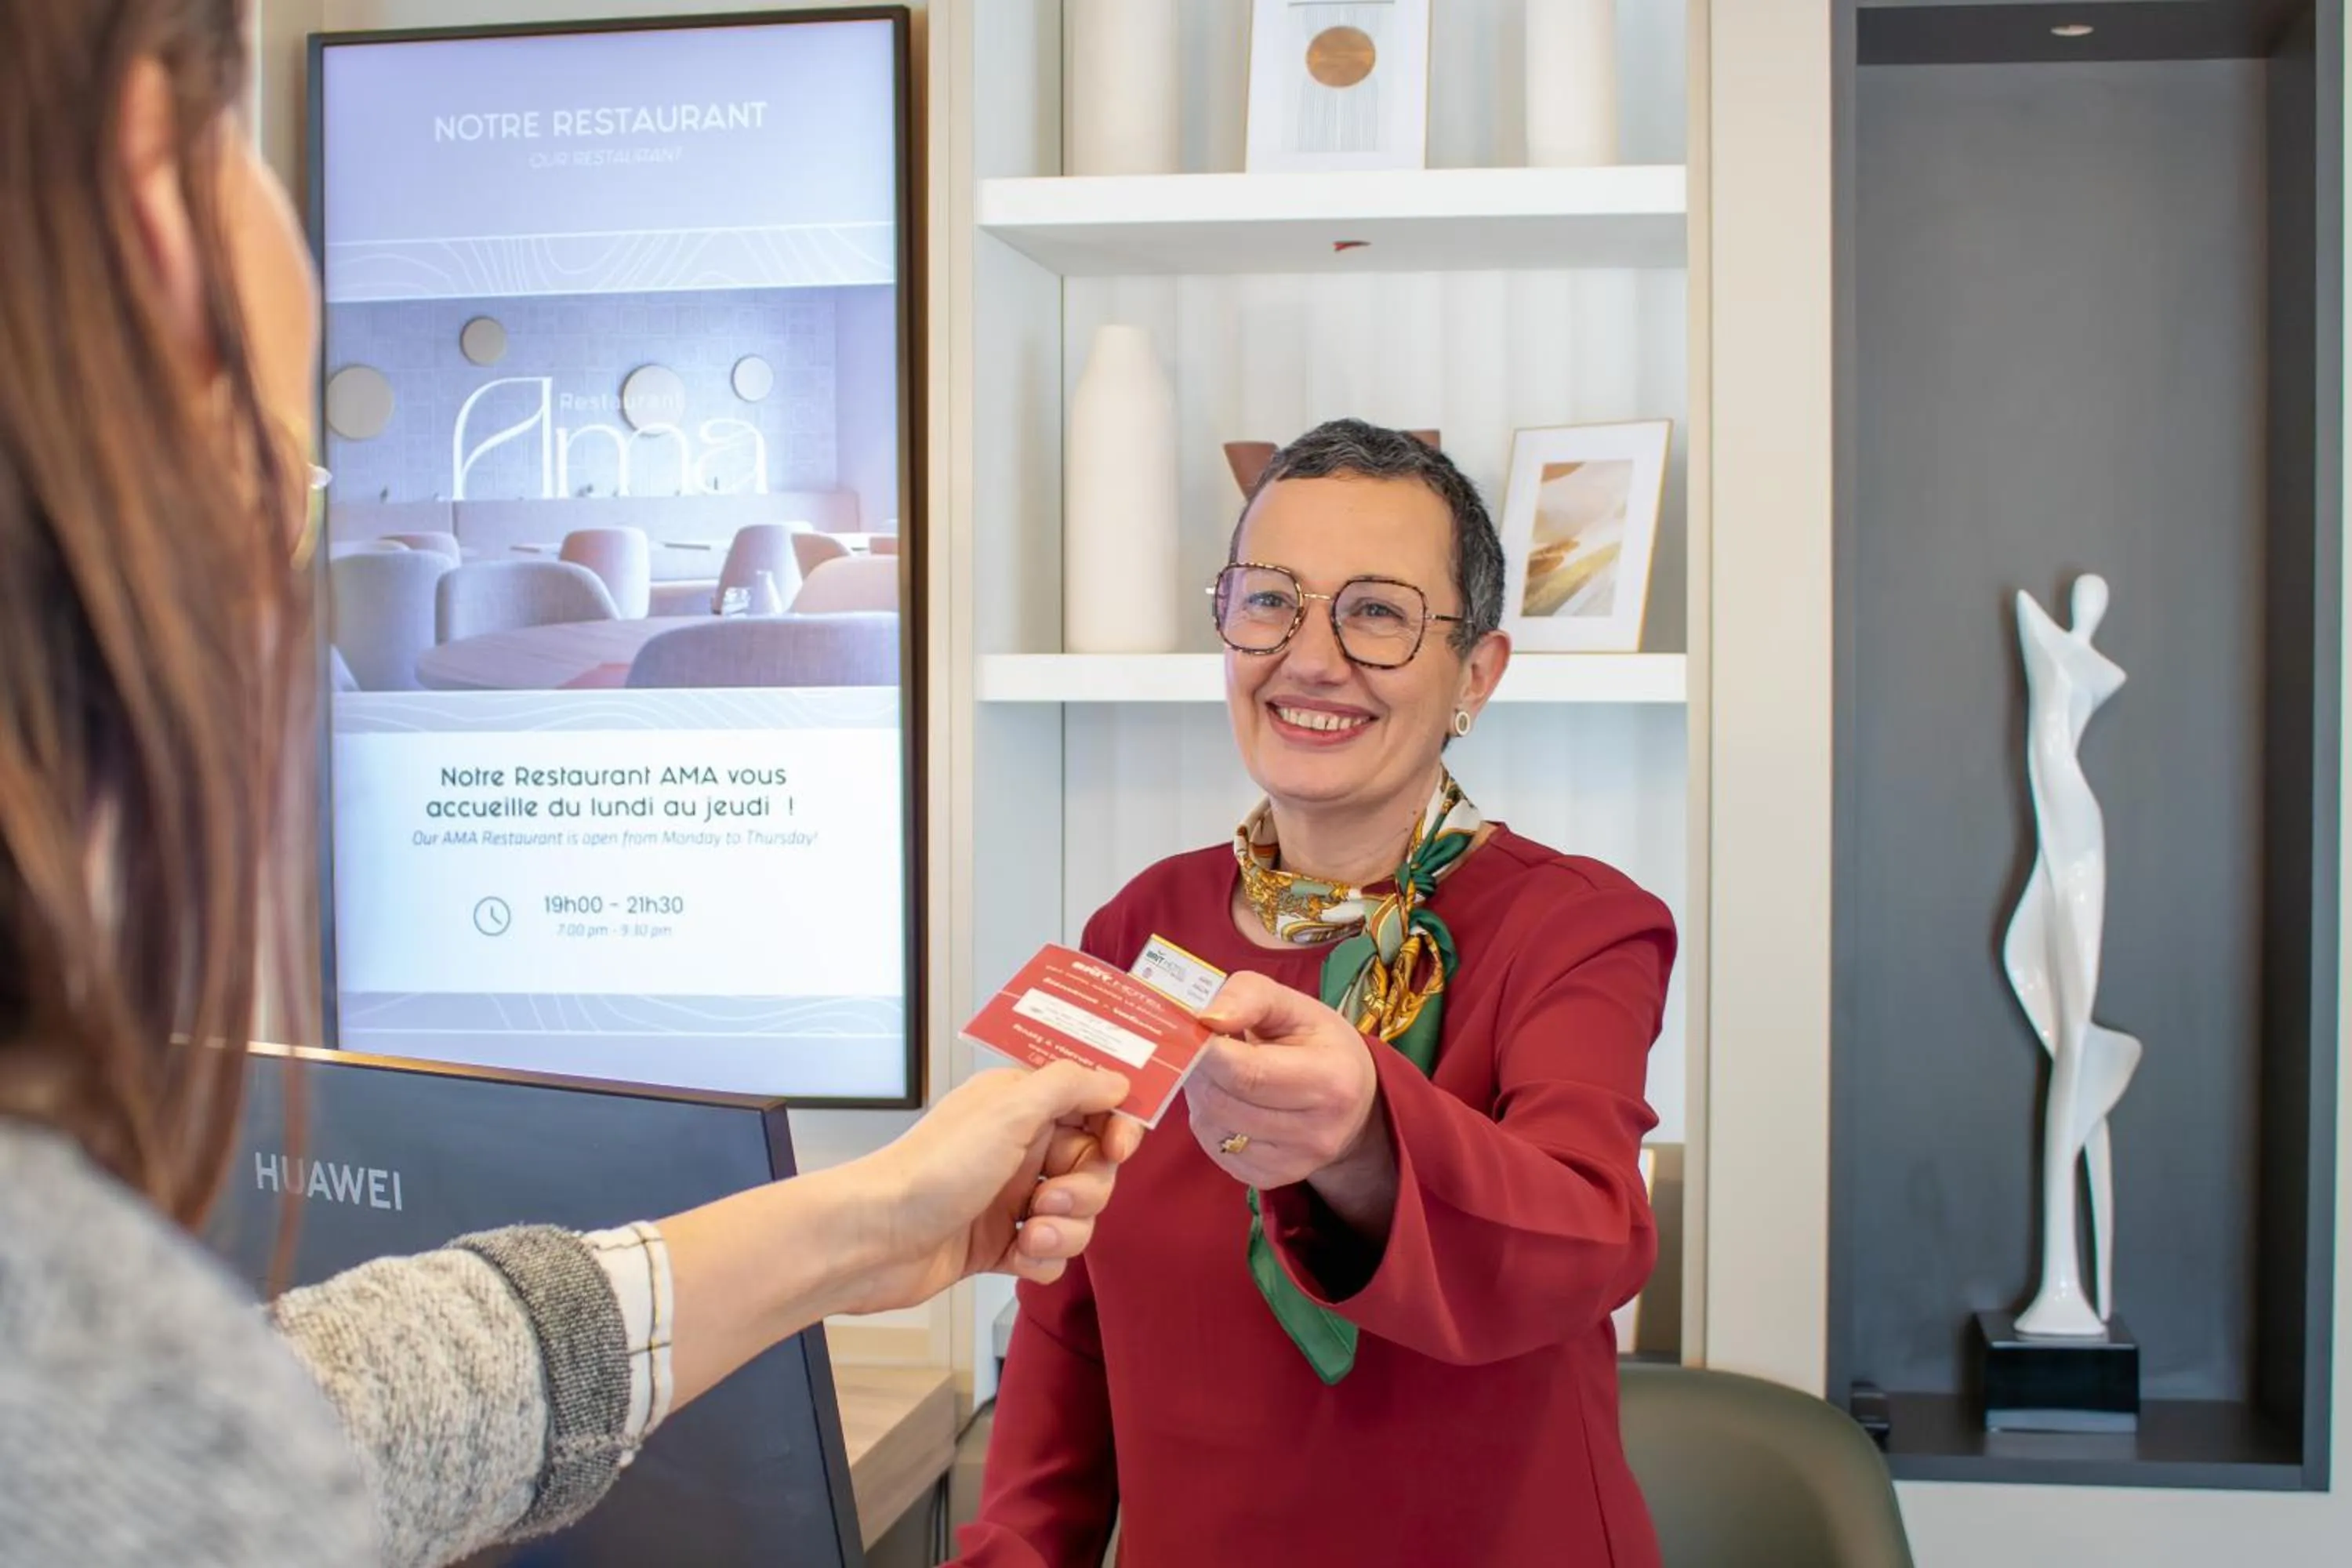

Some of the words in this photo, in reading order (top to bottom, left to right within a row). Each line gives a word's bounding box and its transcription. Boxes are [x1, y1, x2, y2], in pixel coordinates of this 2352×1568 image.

[434, 111, 541, 142] NOTRE
[553, 101, 768, 138] RESTAURANT
[528, 151, 568, 169] OUR
[572, 146, 683, 166] RESTAURANT
[559, 392, 684, 412] Restaurant
[452, 376, 769, 501] Ama
[441, 767, 505, 786] Notre
[515, 765, 651, 786] Restaurant
[659, 766, 720, 786] AMA
[728, 768, 787, 786] vous
[426, 797, 539, 818] accueille
[548, 797, 580, 817] du
[591, 797, 654, 816] lundi
[663, 800, 696, 816] au
[703, 796, 770, 823] jeudi
[412, 829, 438, 846] Our
[441, 830, 478, 844] AMA
[481, 830, 563, 845] Restaurant
[566, 831, 579, 845] is
[582, 833, 618, 848] open
[622, 830, 658, 848] from
[661, 830, 721, 848] Monday
[726, 831, 741, 844] to
[544, 895, 604, 915] 19h00
[626, 895, 684, 915] 21h30
[255, 1152, 402, 1210] HUAWEI
